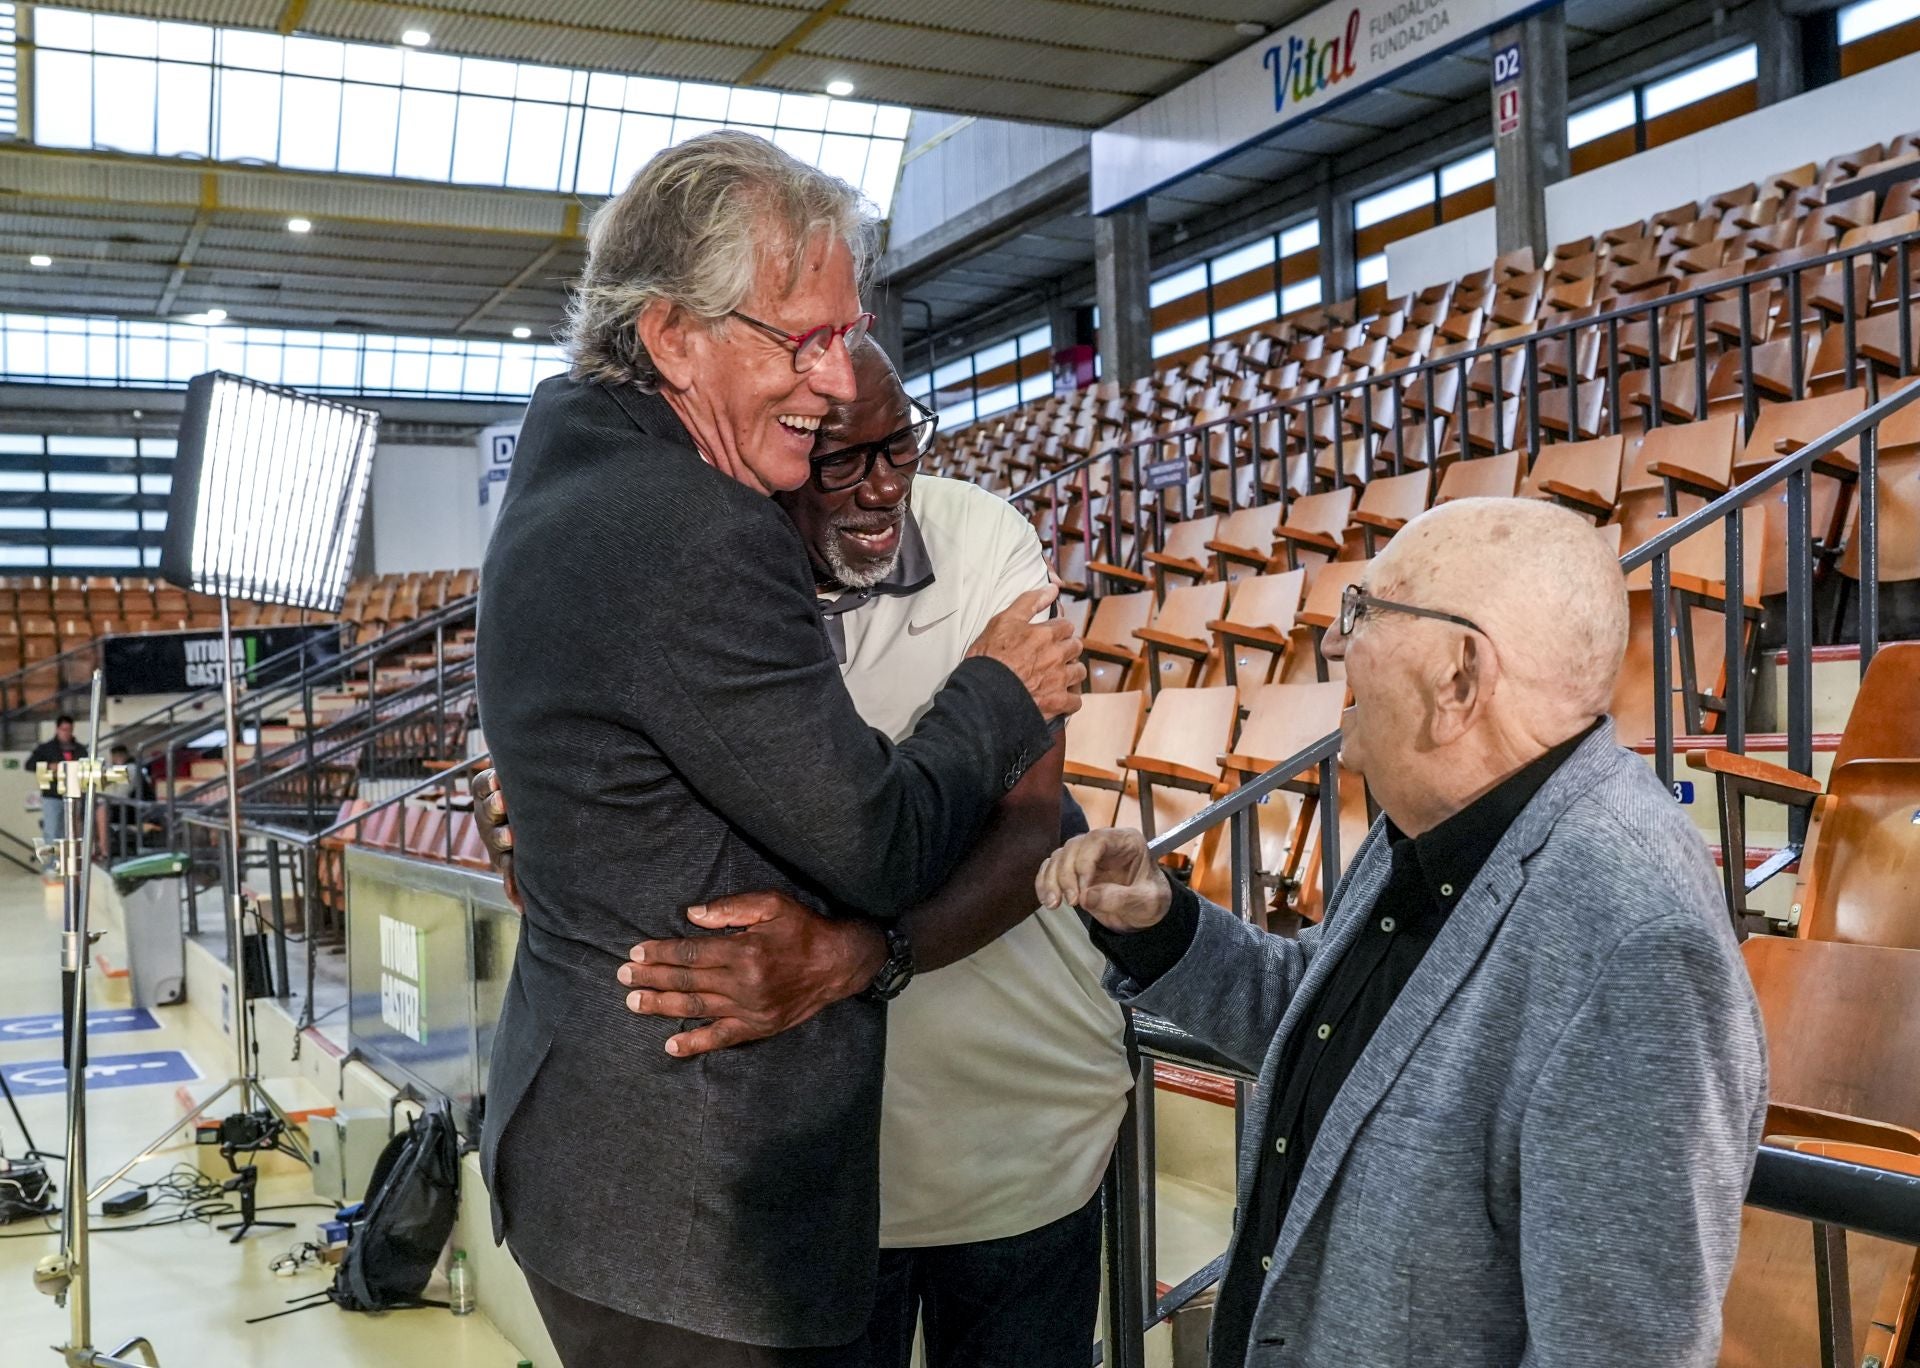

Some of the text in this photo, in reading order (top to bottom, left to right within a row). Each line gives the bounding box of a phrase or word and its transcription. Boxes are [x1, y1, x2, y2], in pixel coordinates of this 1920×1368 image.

[1264, 8, 1360, 112] Vital
[1370, 9, 1450, 62] FUNDAZIOA
[1495, 48, 1519, 81] D2
